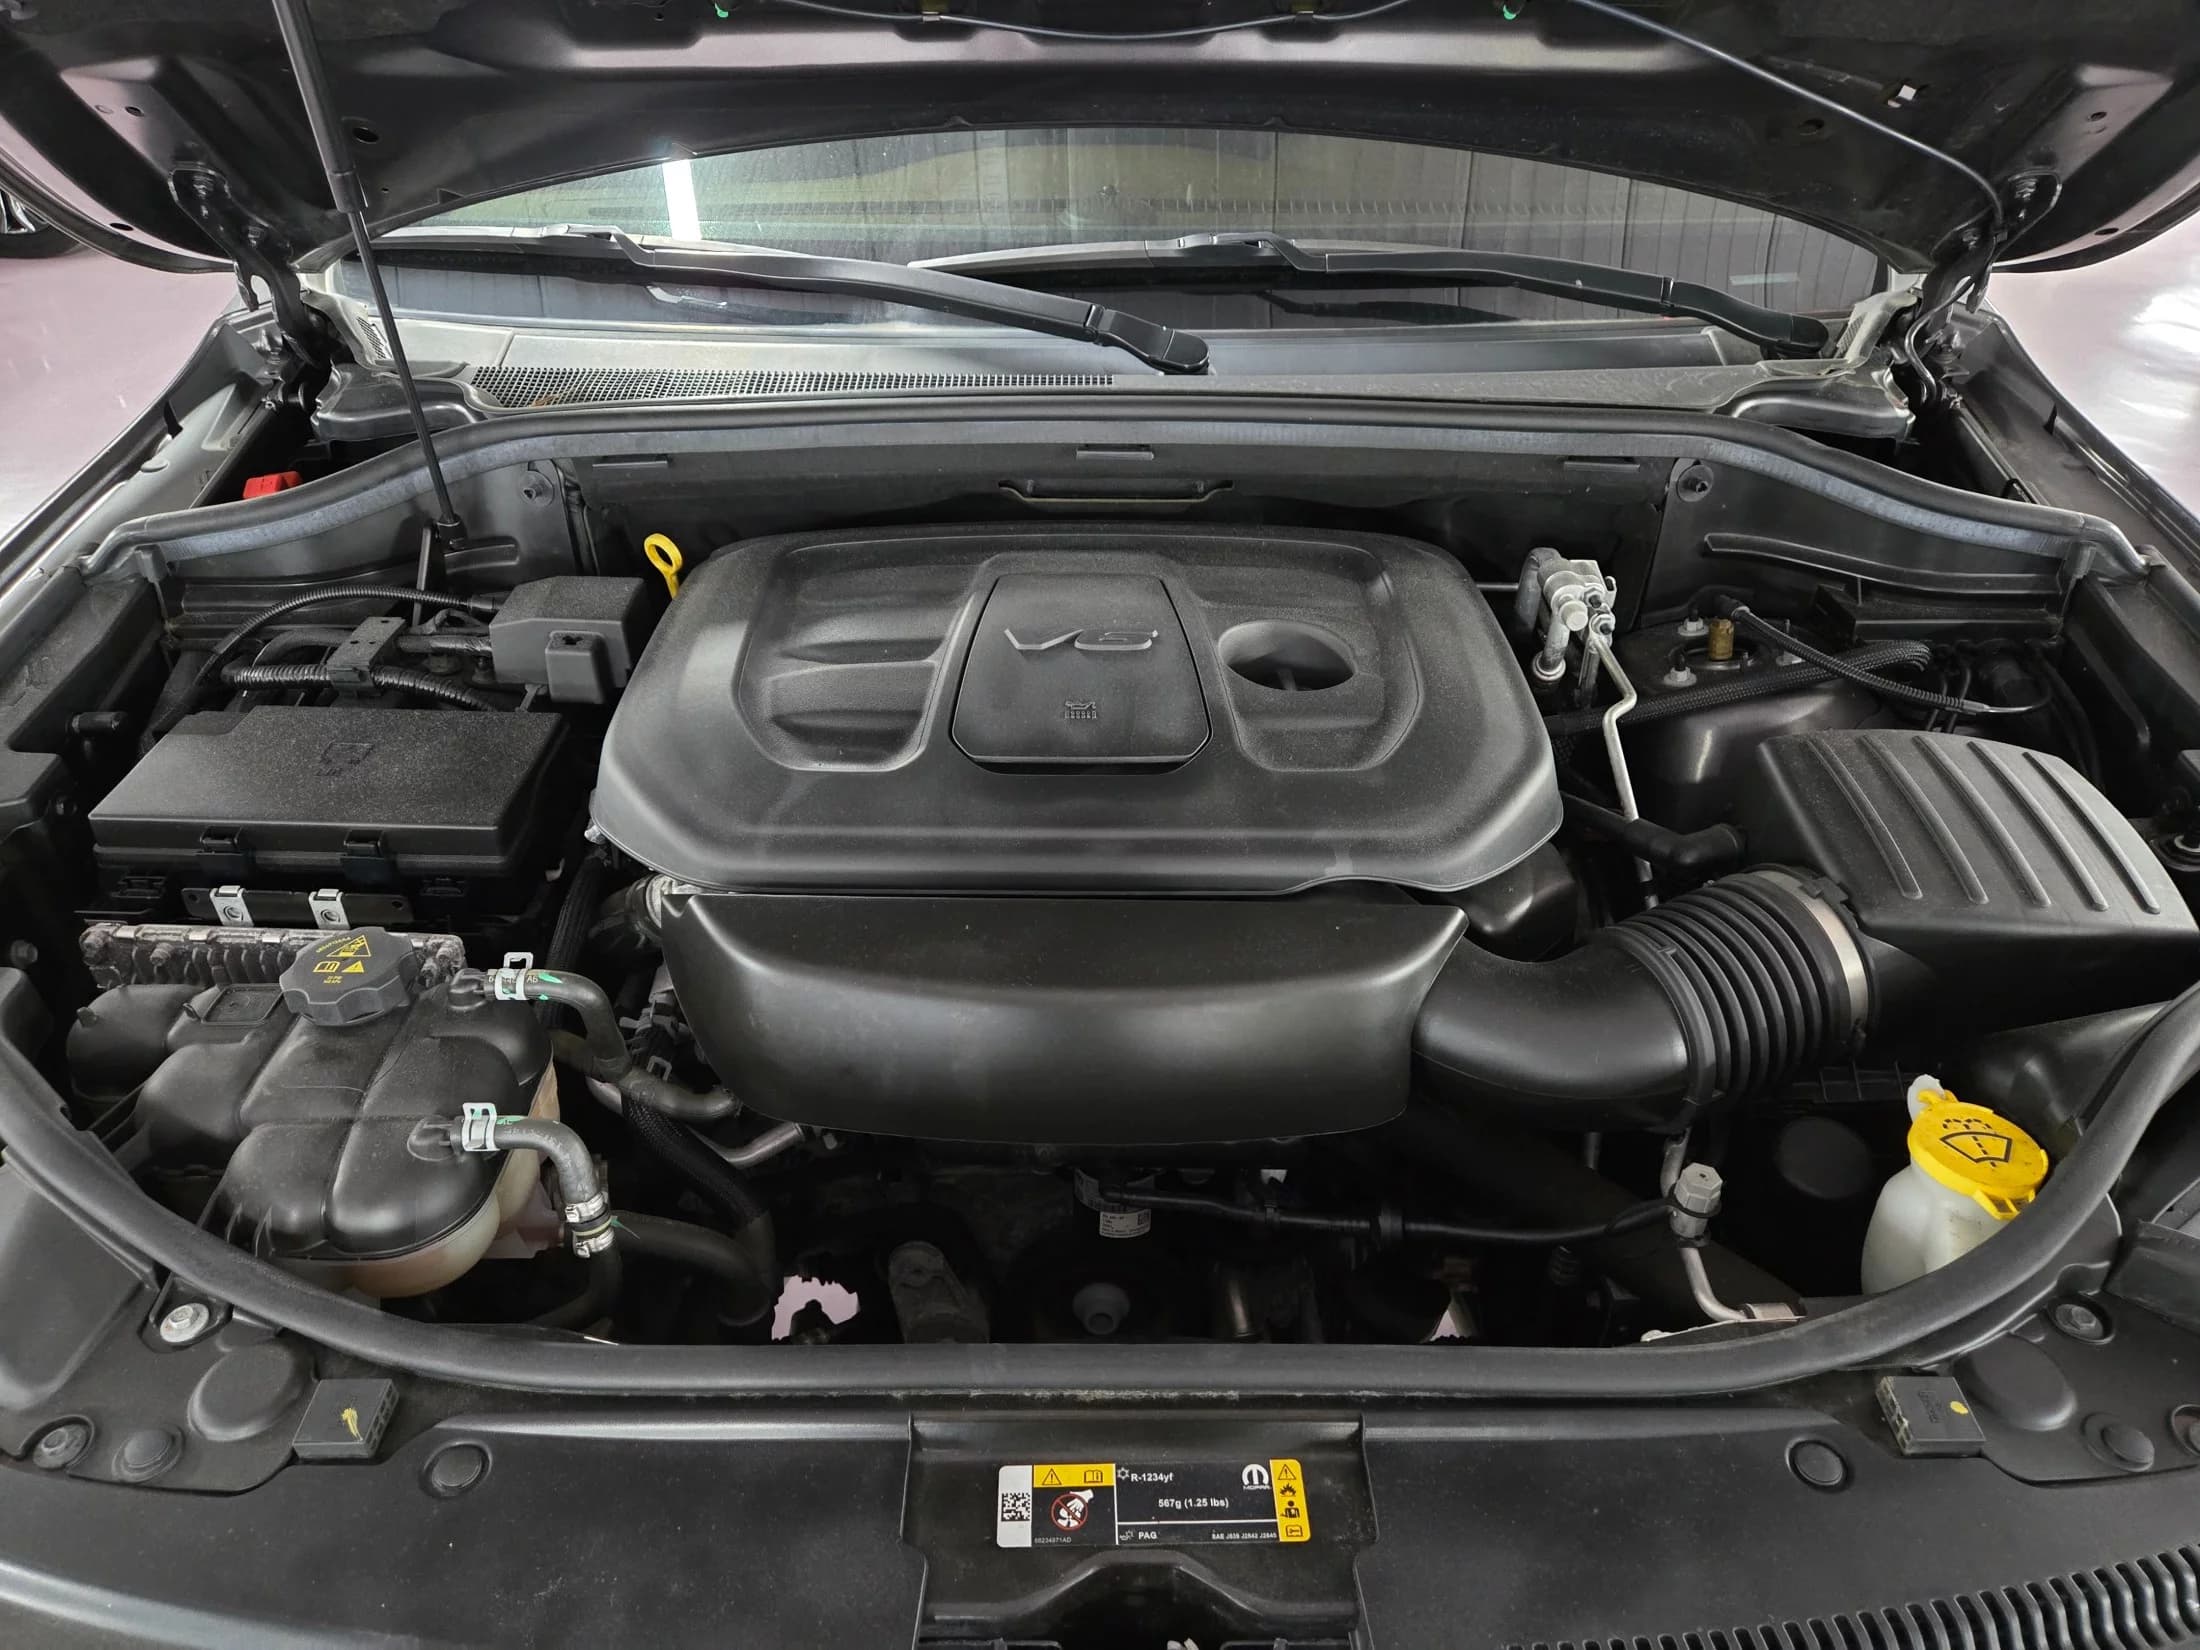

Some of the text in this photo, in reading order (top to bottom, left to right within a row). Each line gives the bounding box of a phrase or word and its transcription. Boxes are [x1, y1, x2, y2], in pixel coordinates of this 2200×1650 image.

[1130, 1472, 1174, 1483] R-1234yf
[1158, 1496, 1230, 1509] 567g (1.25 lbs)
[1138, 1531, 1158, 1540] PAG
